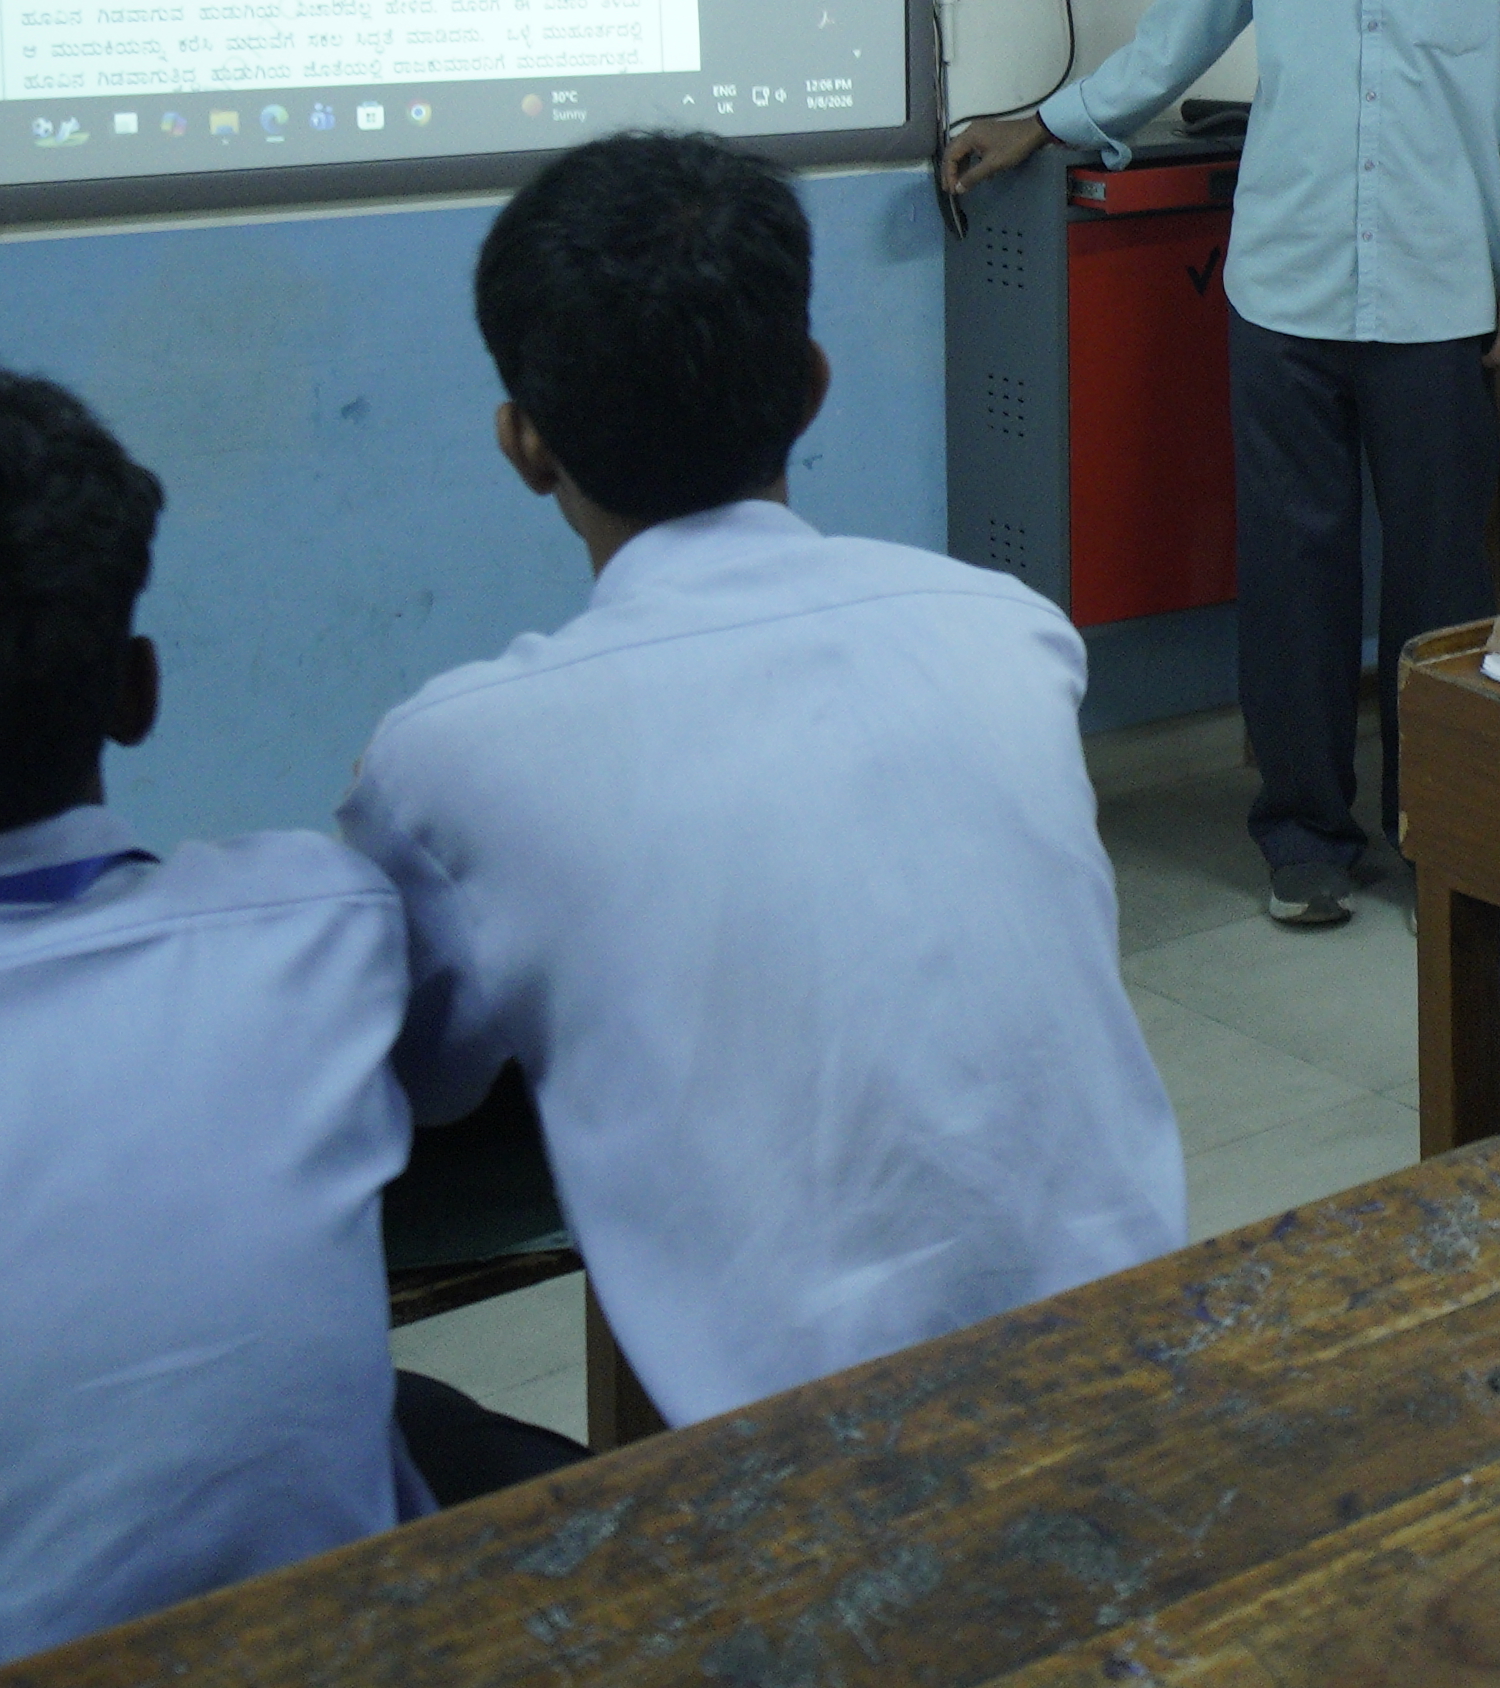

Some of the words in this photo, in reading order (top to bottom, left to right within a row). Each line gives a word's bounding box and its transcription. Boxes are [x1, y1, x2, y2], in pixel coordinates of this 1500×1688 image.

[712, 84, 737, 99] ENG
[834, 78, 853, 92] PM
[717, 100, 735, 115] UK
[551, 108, 587, 123] Sunny
